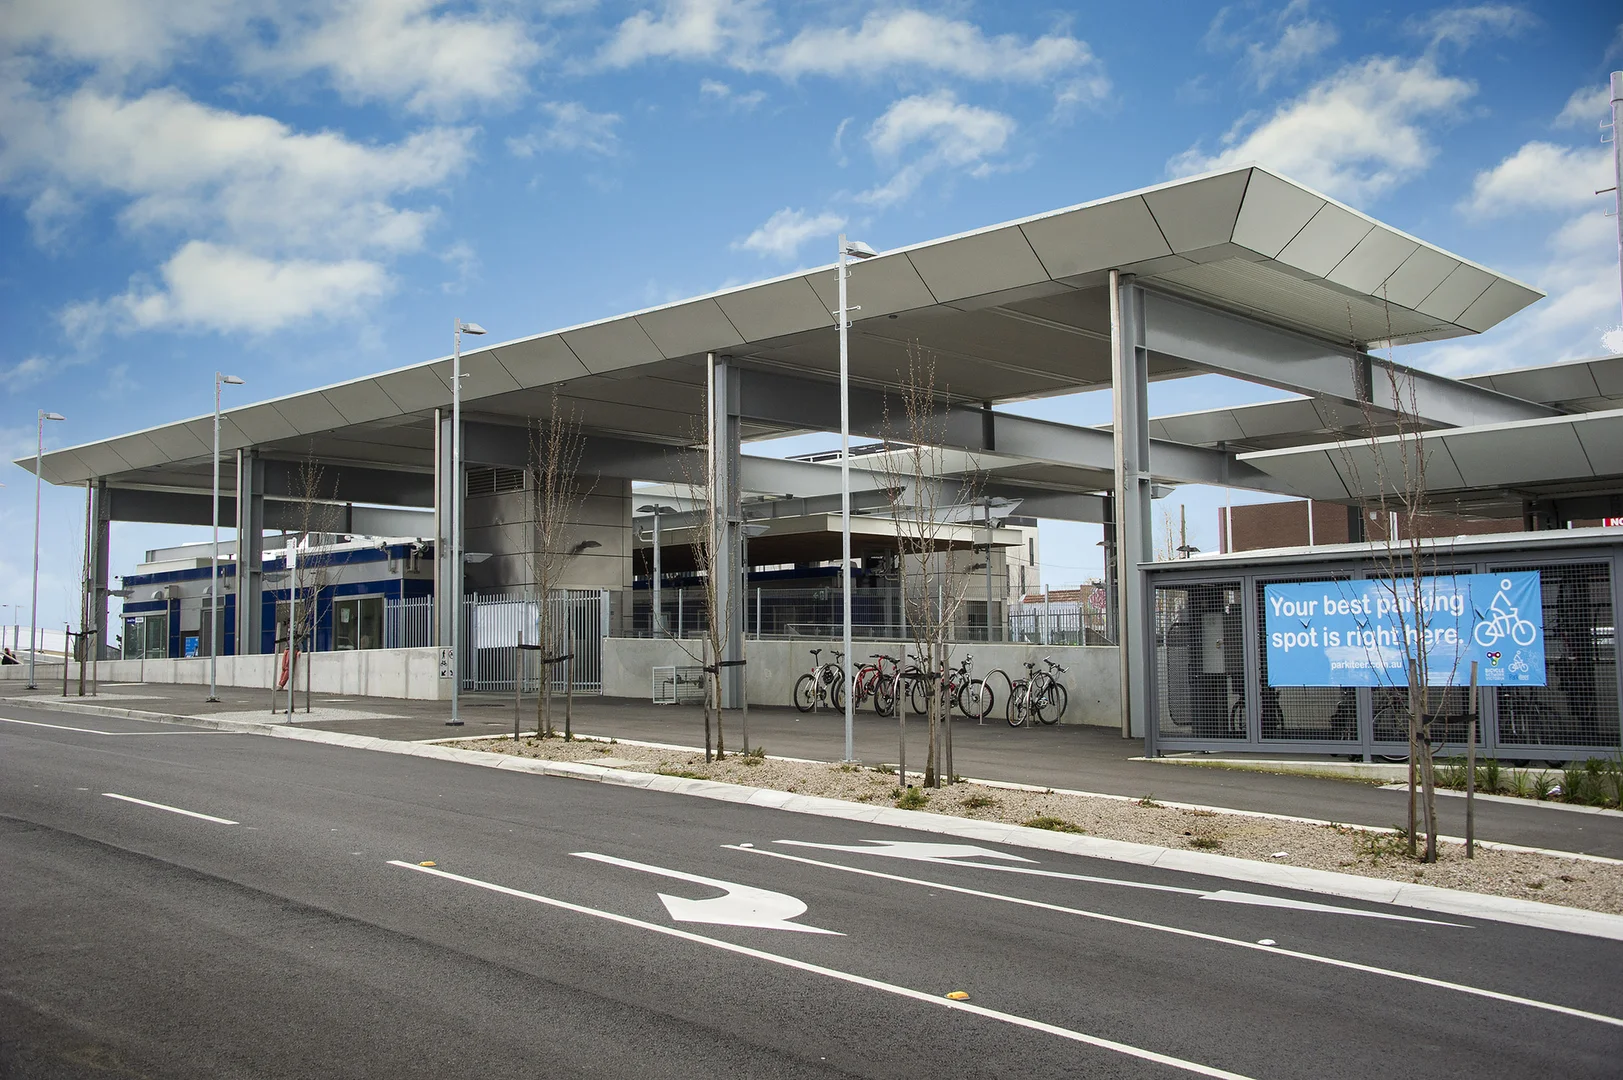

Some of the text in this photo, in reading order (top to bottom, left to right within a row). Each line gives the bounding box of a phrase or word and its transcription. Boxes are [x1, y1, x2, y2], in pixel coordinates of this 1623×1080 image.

[1270, 591, 1464, 619] Your best parking
[1272, 624, 1464, 652] spot is right here.
[1331, 660, 1402, 670] parkiteer.com.au
